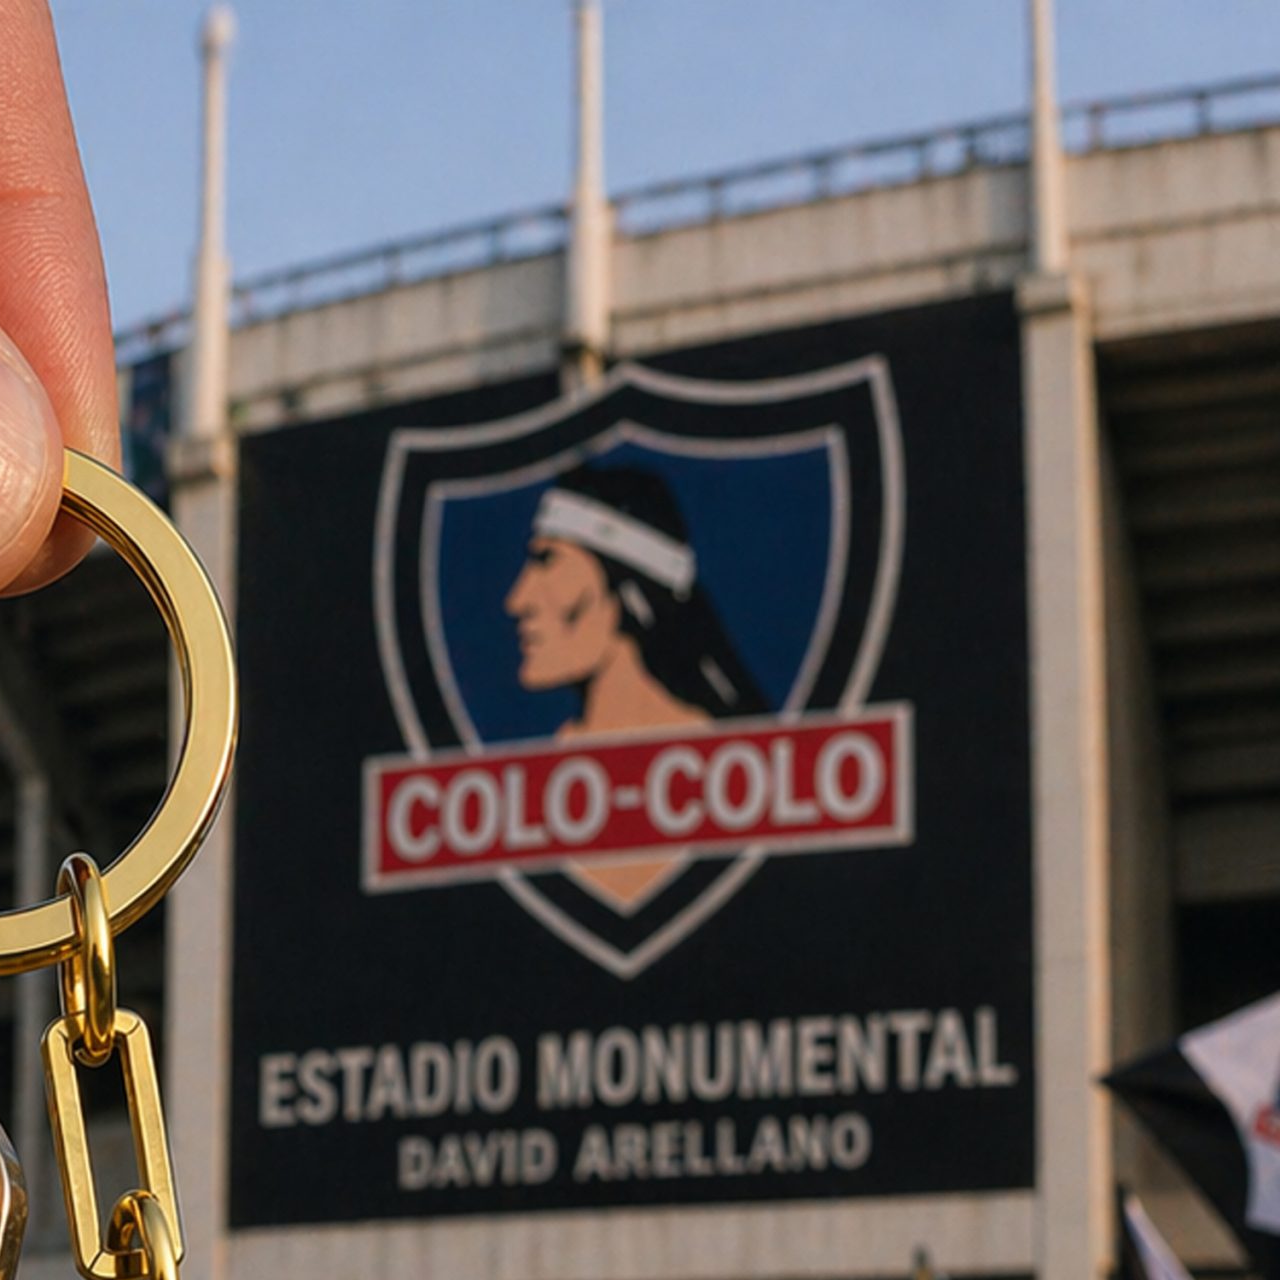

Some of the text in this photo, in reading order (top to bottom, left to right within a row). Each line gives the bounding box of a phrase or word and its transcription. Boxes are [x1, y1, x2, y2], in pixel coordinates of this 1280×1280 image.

[385, 732, 885, 862] COLO-COLO
[258, 1007, 1017, 1129] ESTADIO MONUMENTAL
[397, 1113, 873, 1191] DAVID ARELLANO
